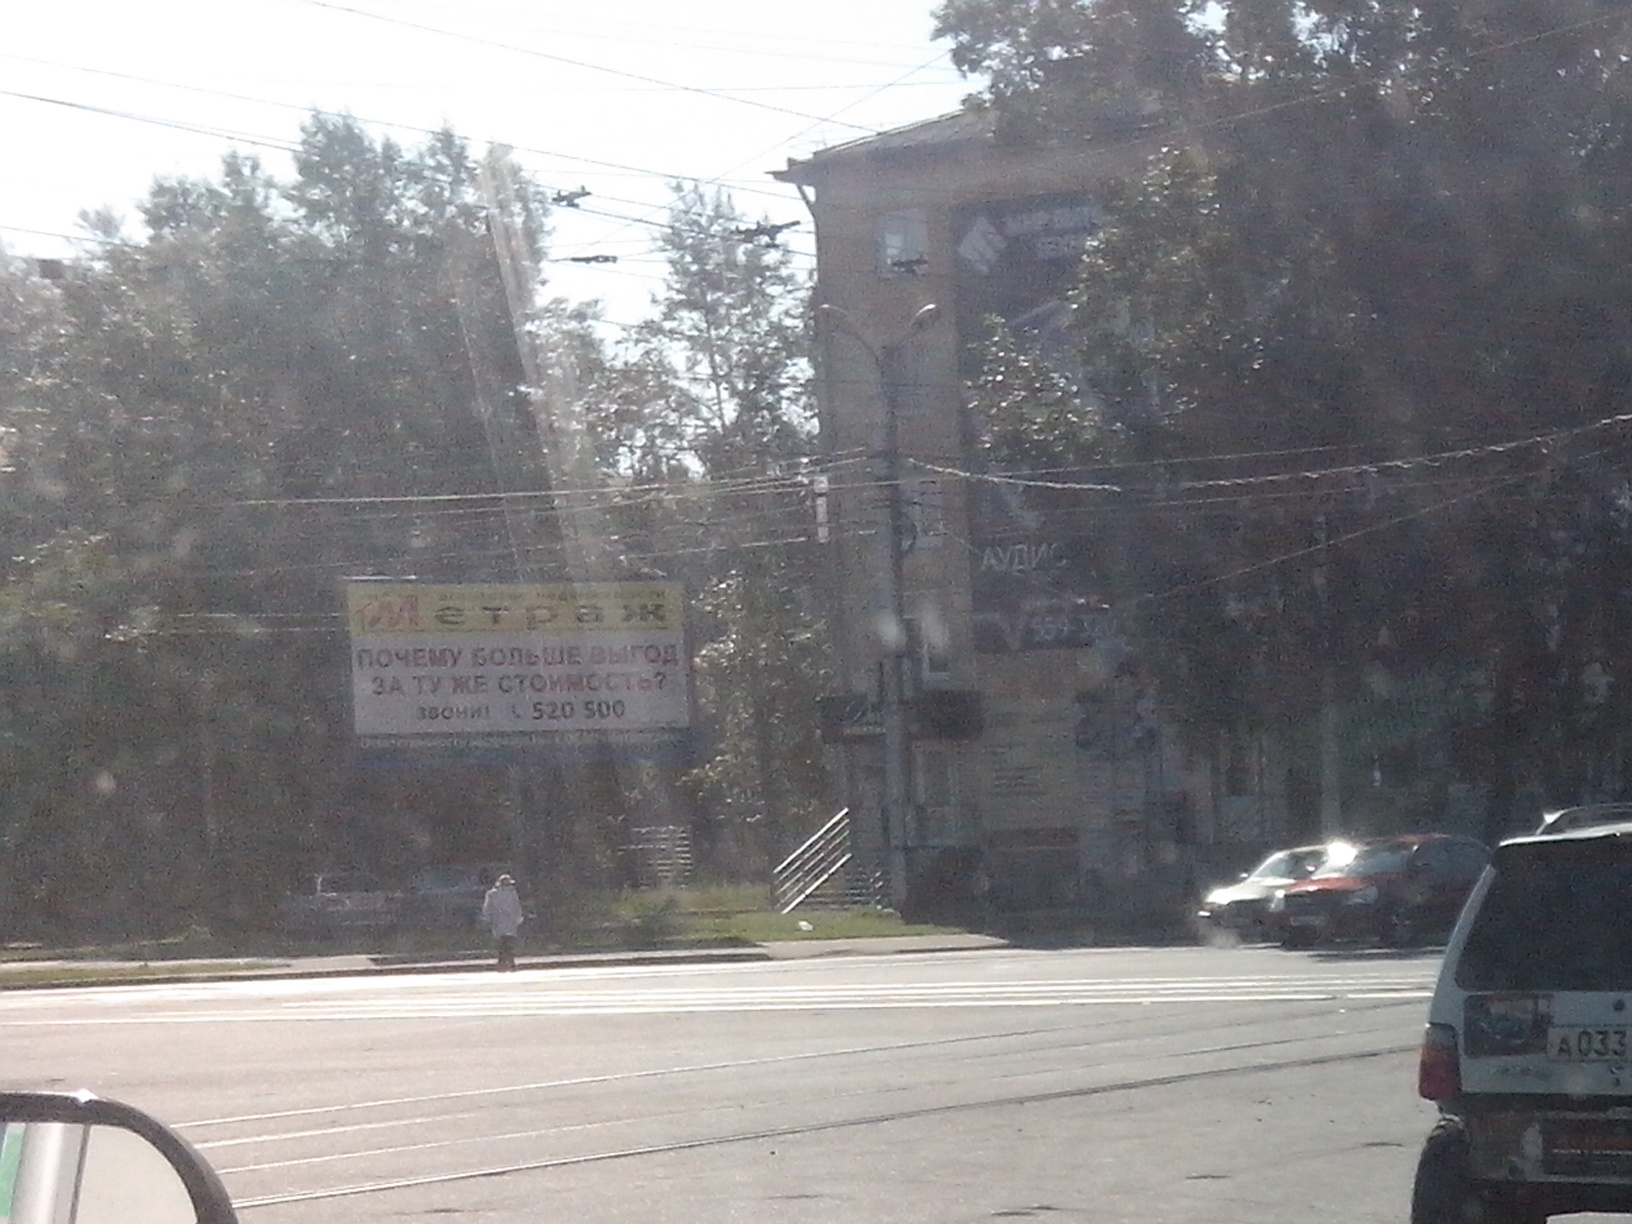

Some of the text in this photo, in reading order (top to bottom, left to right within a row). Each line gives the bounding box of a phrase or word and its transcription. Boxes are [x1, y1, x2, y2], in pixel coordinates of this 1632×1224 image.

[358, 648, 461, 667] ПОЧЕМУ
[471, 647, 581, 666] БОЛЬШЕ
[371, 672, 667, 695] ЗА ТУ ЖЕ СТОИМОСТЬ?
[531, 701, 575, 720] 520
[583, 699, 626, 719] 500
